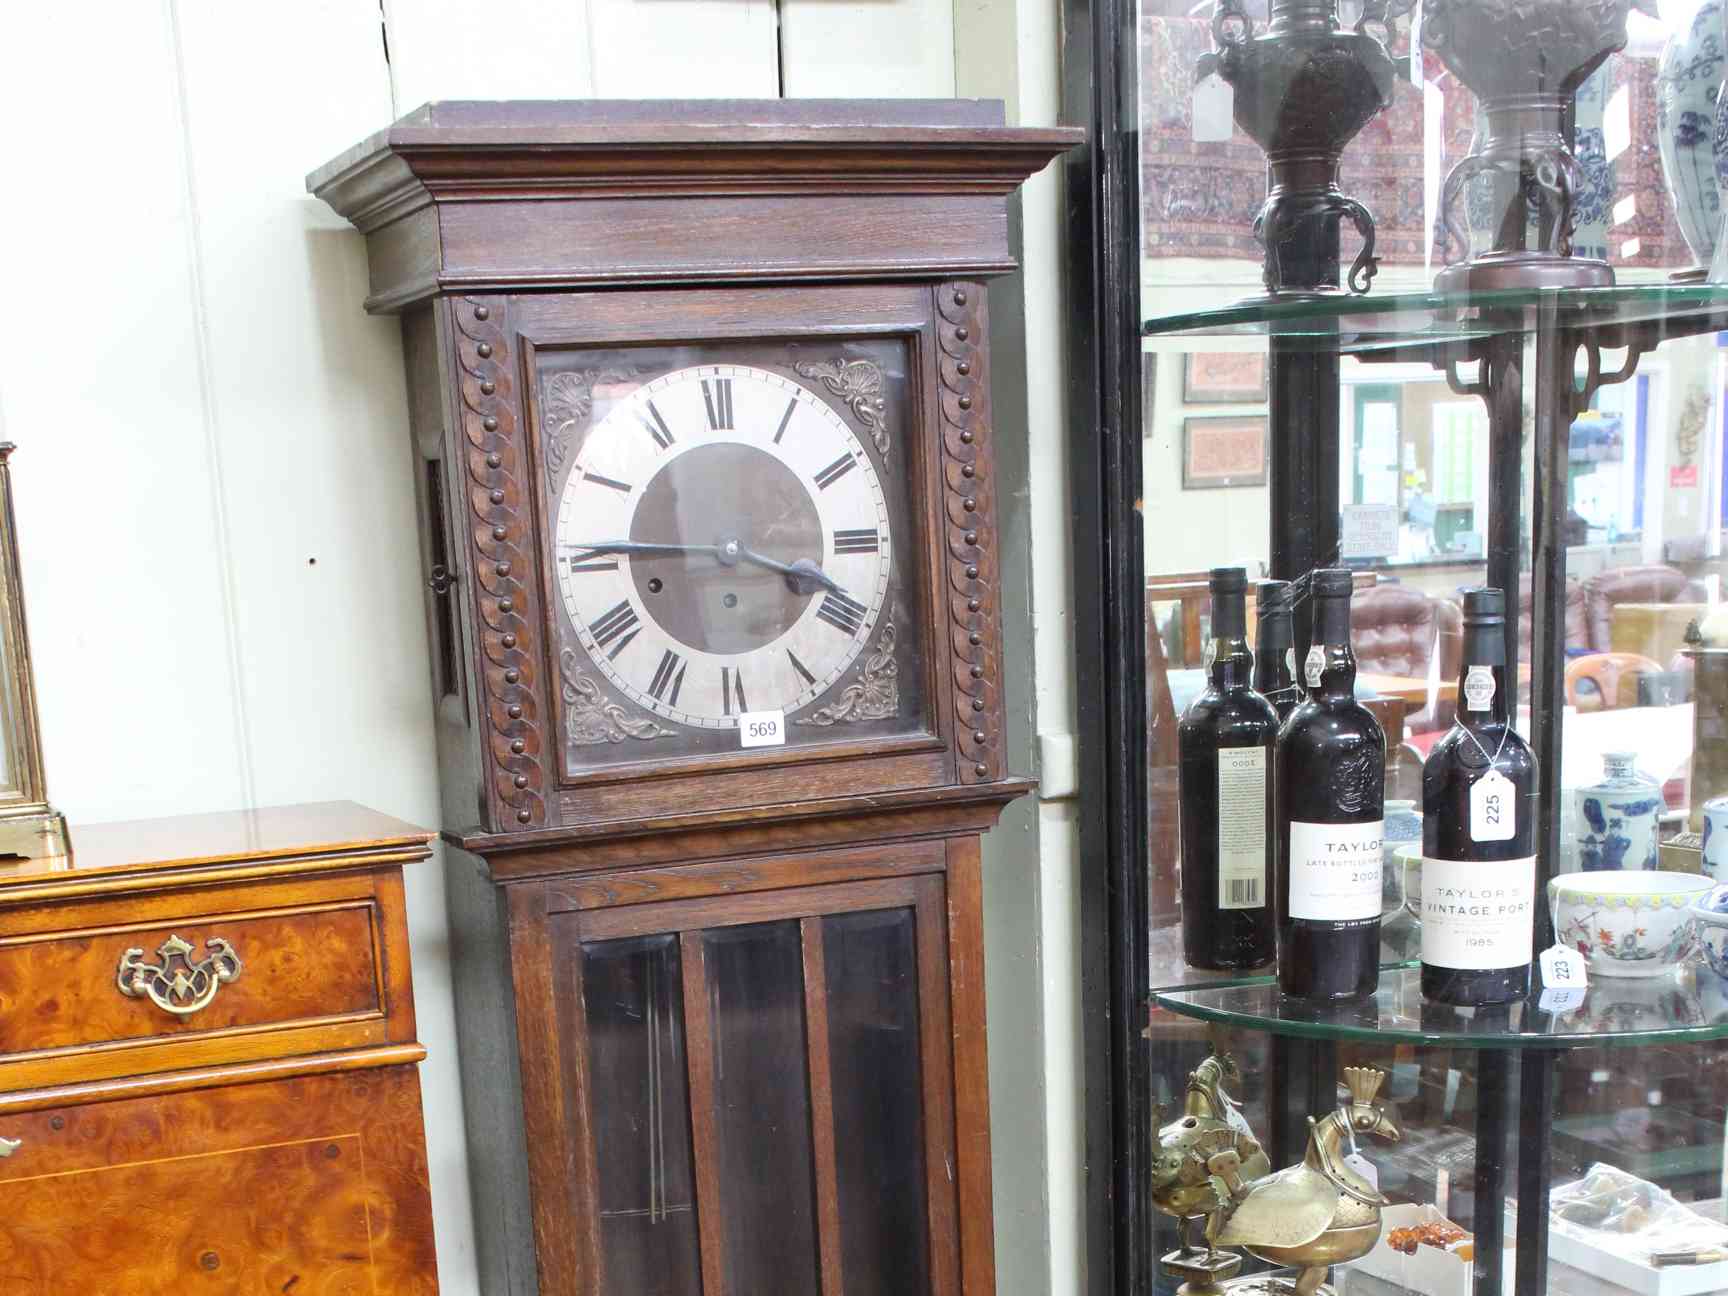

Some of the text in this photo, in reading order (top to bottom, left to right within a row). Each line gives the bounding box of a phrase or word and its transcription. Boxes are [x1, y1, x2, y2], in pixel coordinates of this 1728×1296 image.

[749, 720, 777, 737] 569
[1485, 794, 1500, 824] 225
[1426, 903, 1489, 916] VINTAGE
[1554, 960, 1570, 980] 223
